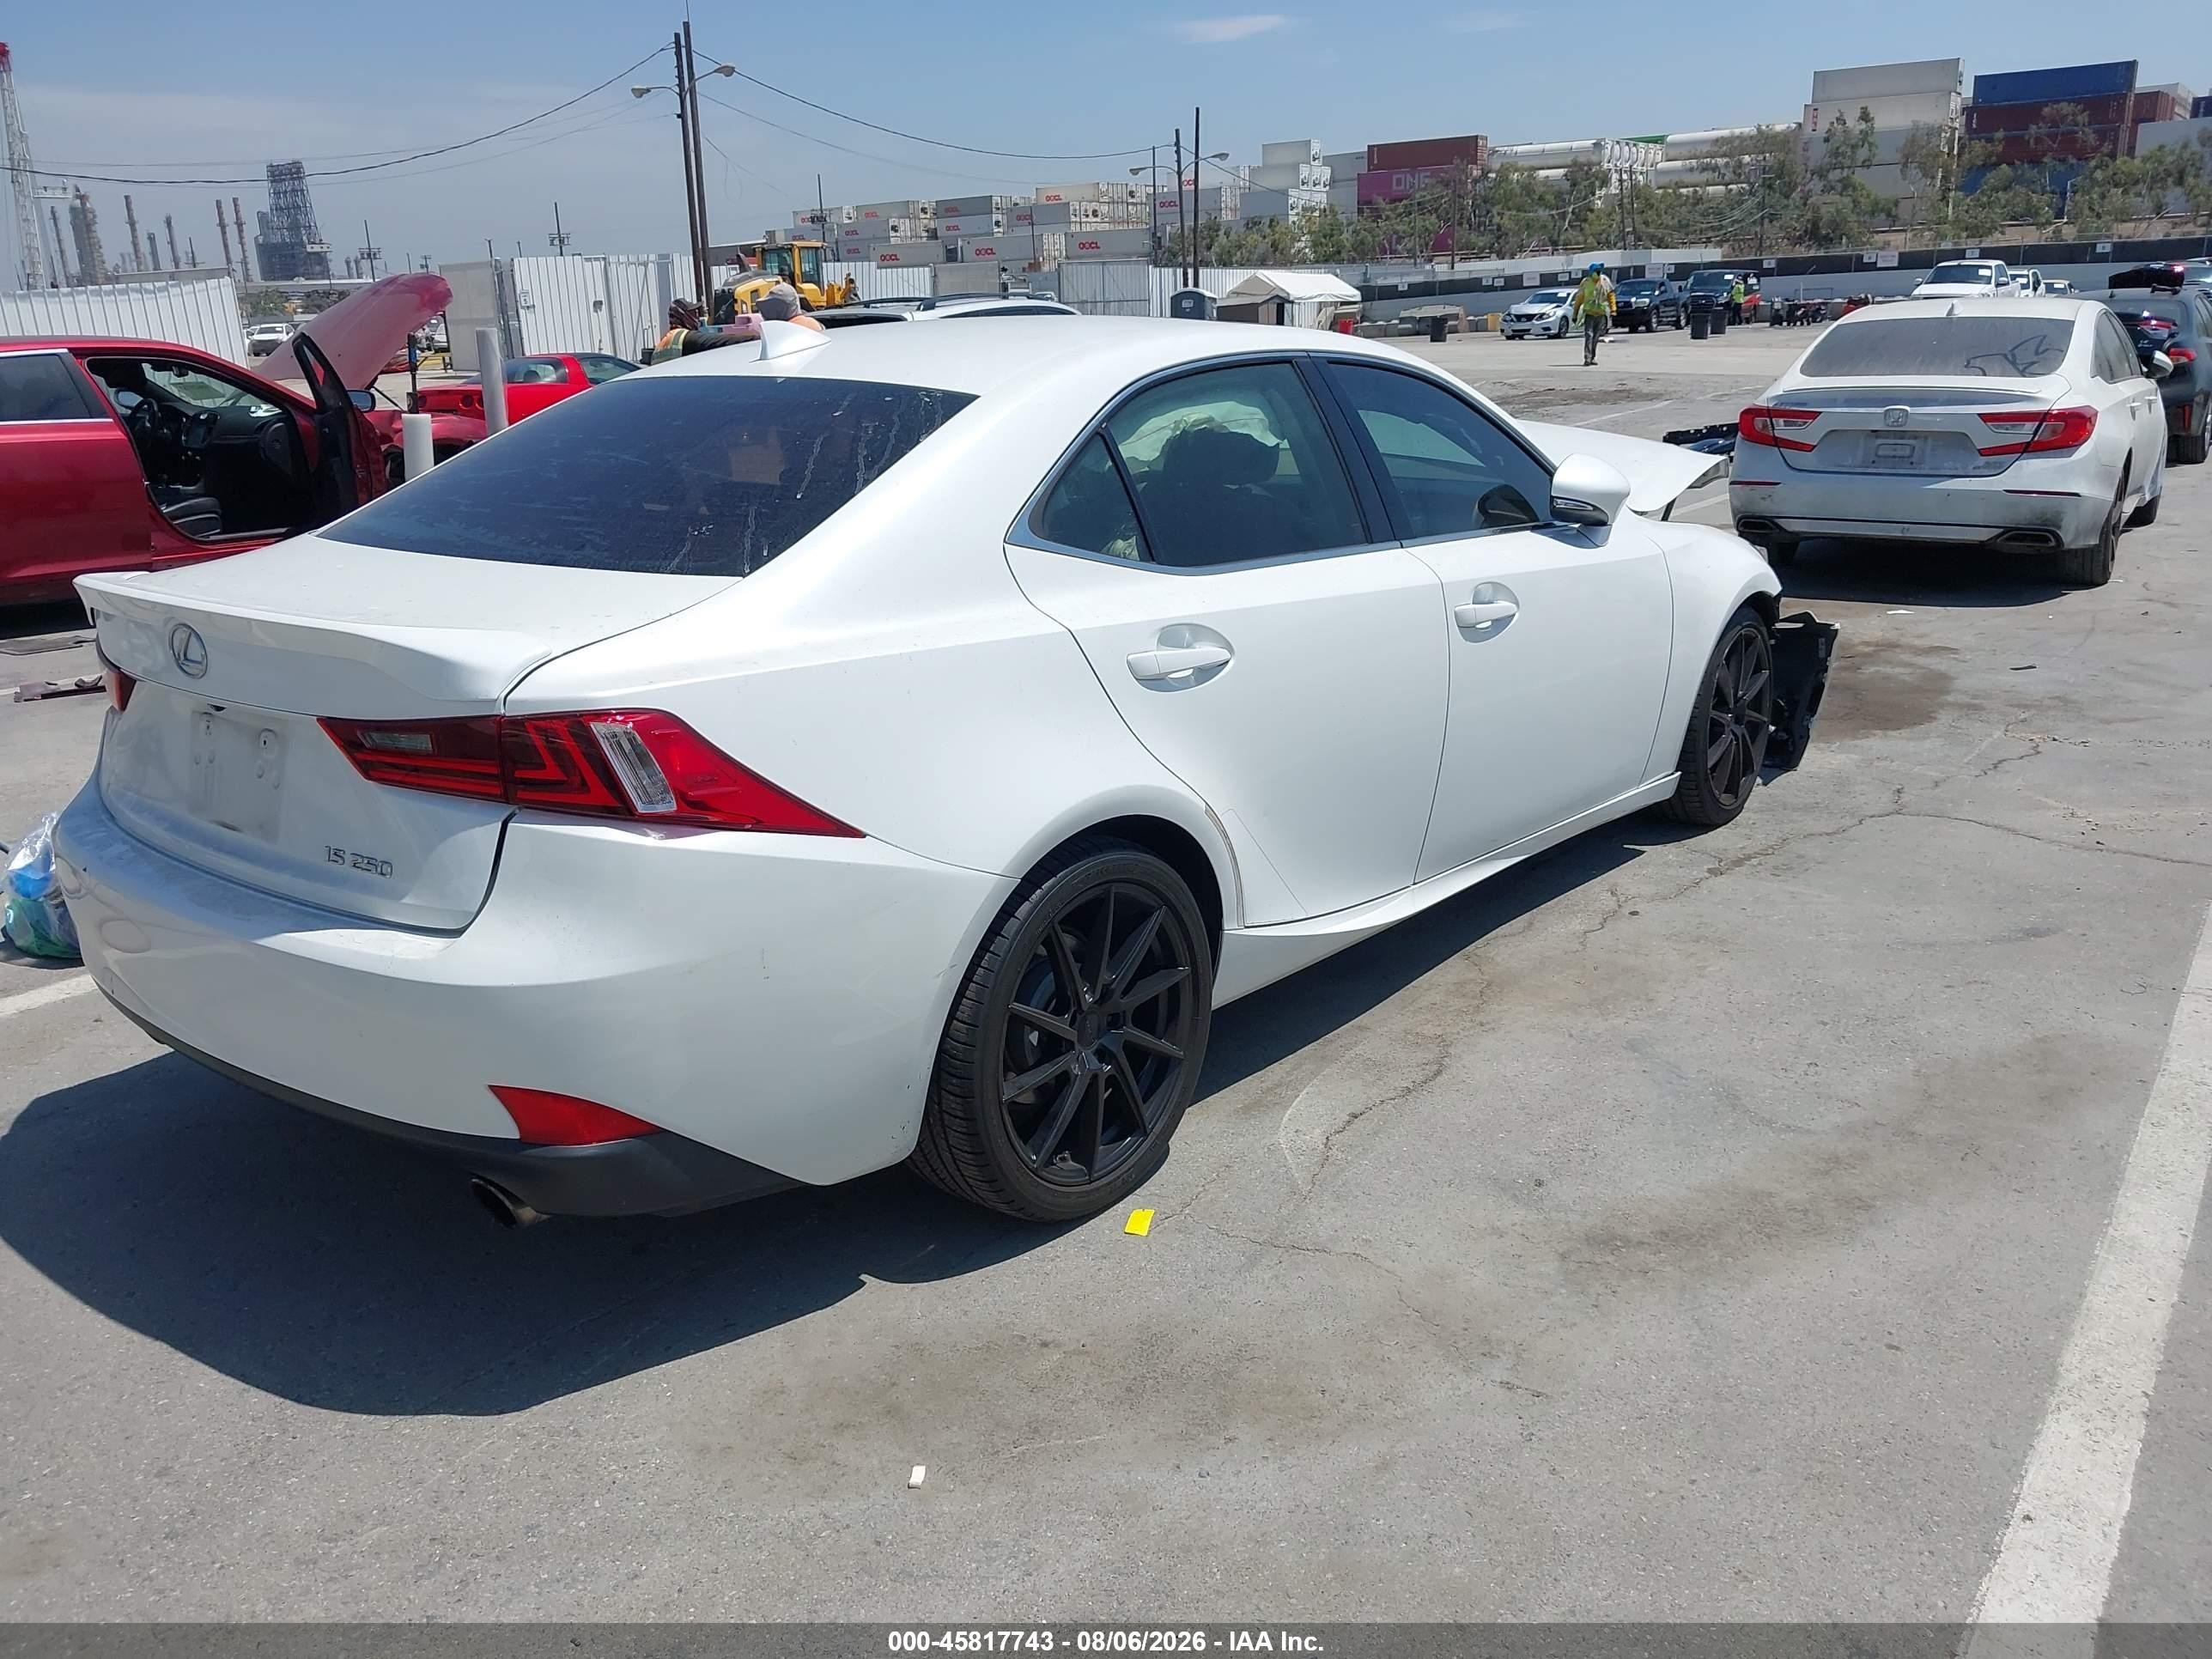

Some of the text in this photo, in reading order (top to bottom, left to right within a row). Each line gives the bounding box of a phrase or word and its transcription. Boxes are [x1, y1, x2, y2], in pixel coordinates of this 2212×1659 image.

[1079, 240, 1101, 250] OOCL
[975, 246, 997, 257] OOCL
[879, 253, 900, 262] OOCL
[349, 852, 393, 879] 250
